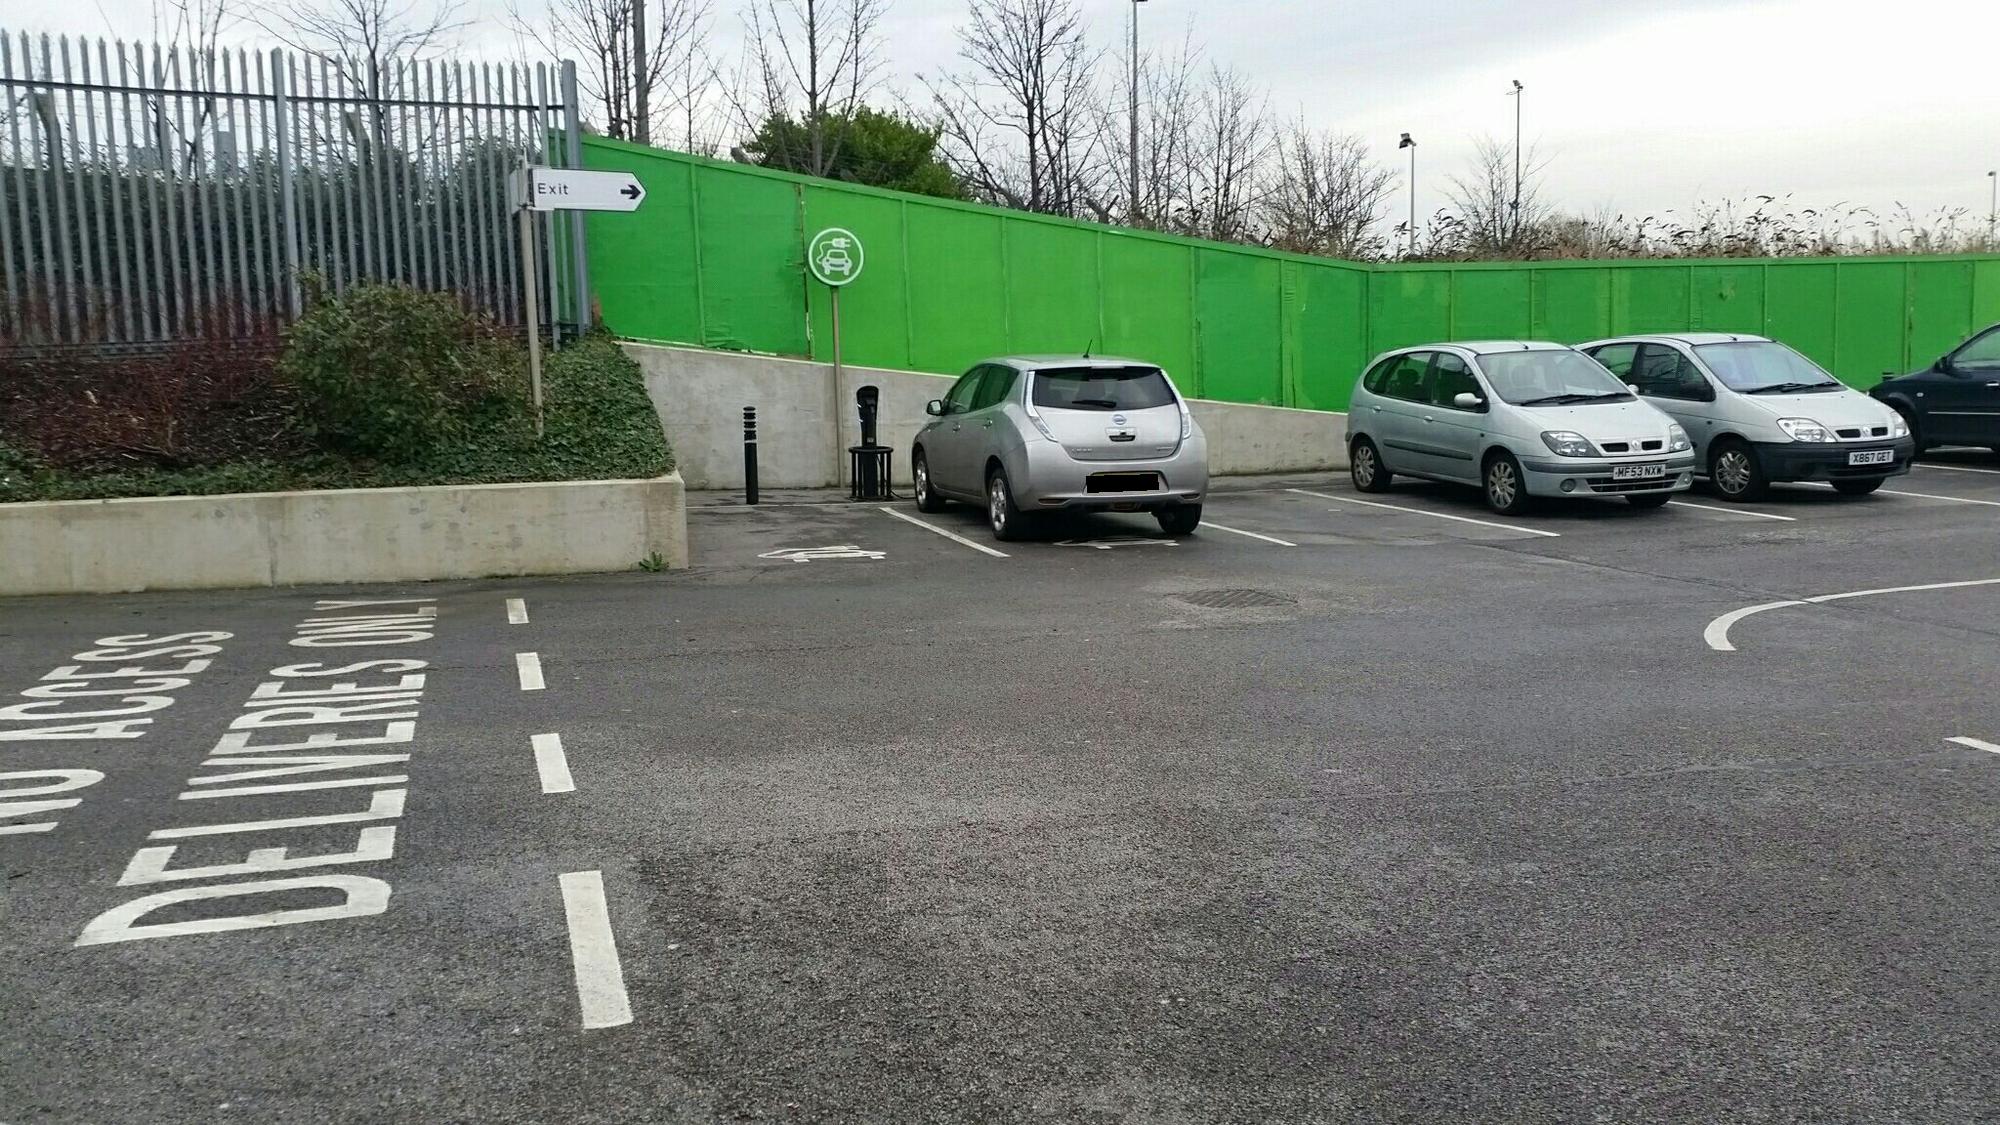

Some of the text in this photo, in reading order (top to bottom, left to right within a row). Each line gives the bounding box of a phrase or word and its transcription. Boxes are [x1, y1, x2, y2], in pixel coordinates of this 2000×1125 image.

[537, 182, 569, 196] Exit
[1852, 451, 1892, 464] X867 GET
[1617, 466, 1643, 478] MF53
[0, 631, 235, 741] ACCESS
[75, 599, 438, 948] DELIVERIES ONLY
